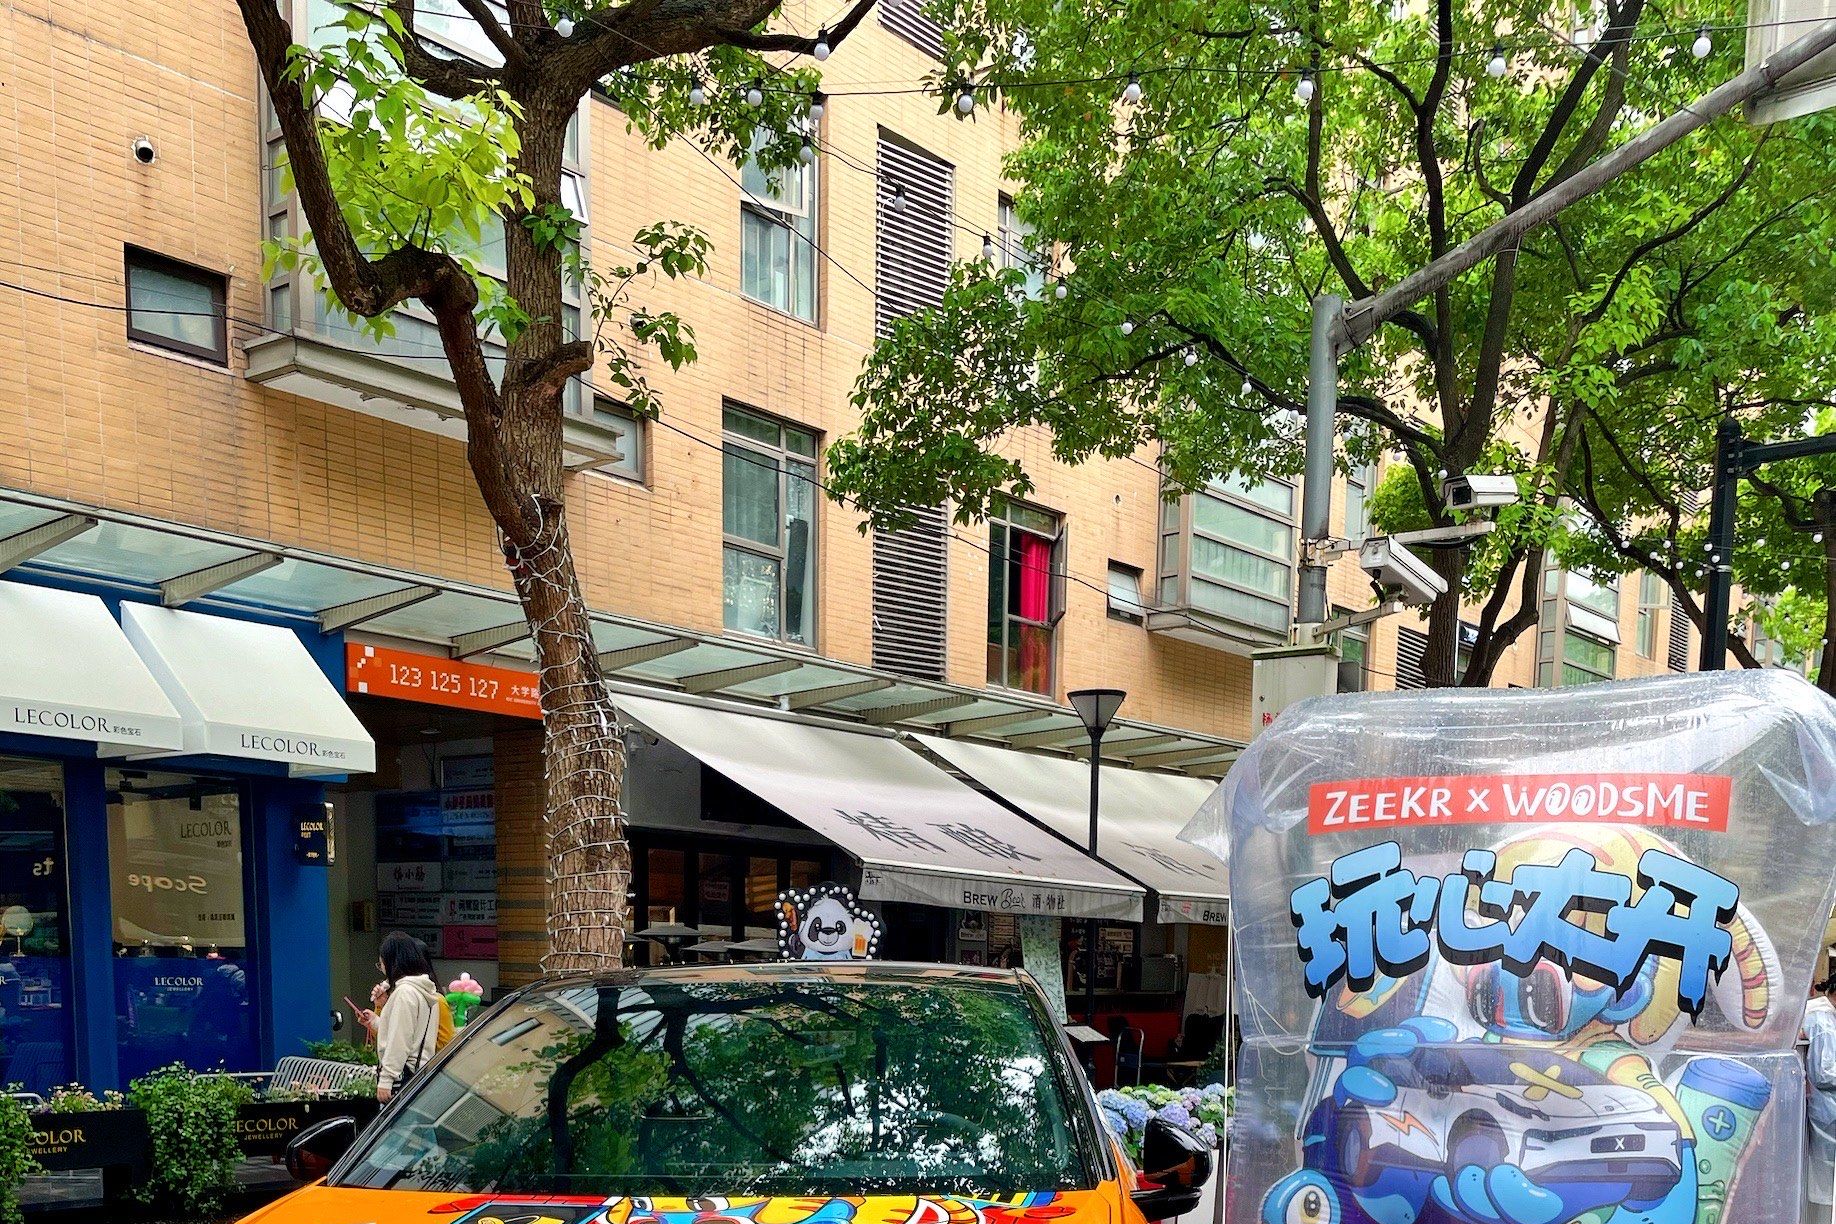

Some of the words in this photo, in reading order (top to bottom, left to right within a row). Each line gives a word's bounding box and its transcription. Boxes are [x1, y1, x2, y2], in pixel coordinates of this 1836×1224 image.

[390, 663, 422, 688] 123
[430, 670, 461, 694] 125
[469, 677, 499, 700] 127
[14, 707, 111, 733] LECOLOR
[241, 733, 320, 757] LECOLOR
[1322, 787, 1452, 827] ZEEKR
[1502, 783, 1710, 823] WOODSME
[180, 820, 233, 839] LECOLOR
[963, 890, 999, 907] BREW
[154, 976, 205, 986] LECOLOR
[236, 1117, 299, 1133] ECOLOR
[22, 1128, 87, 1146] COLOR
